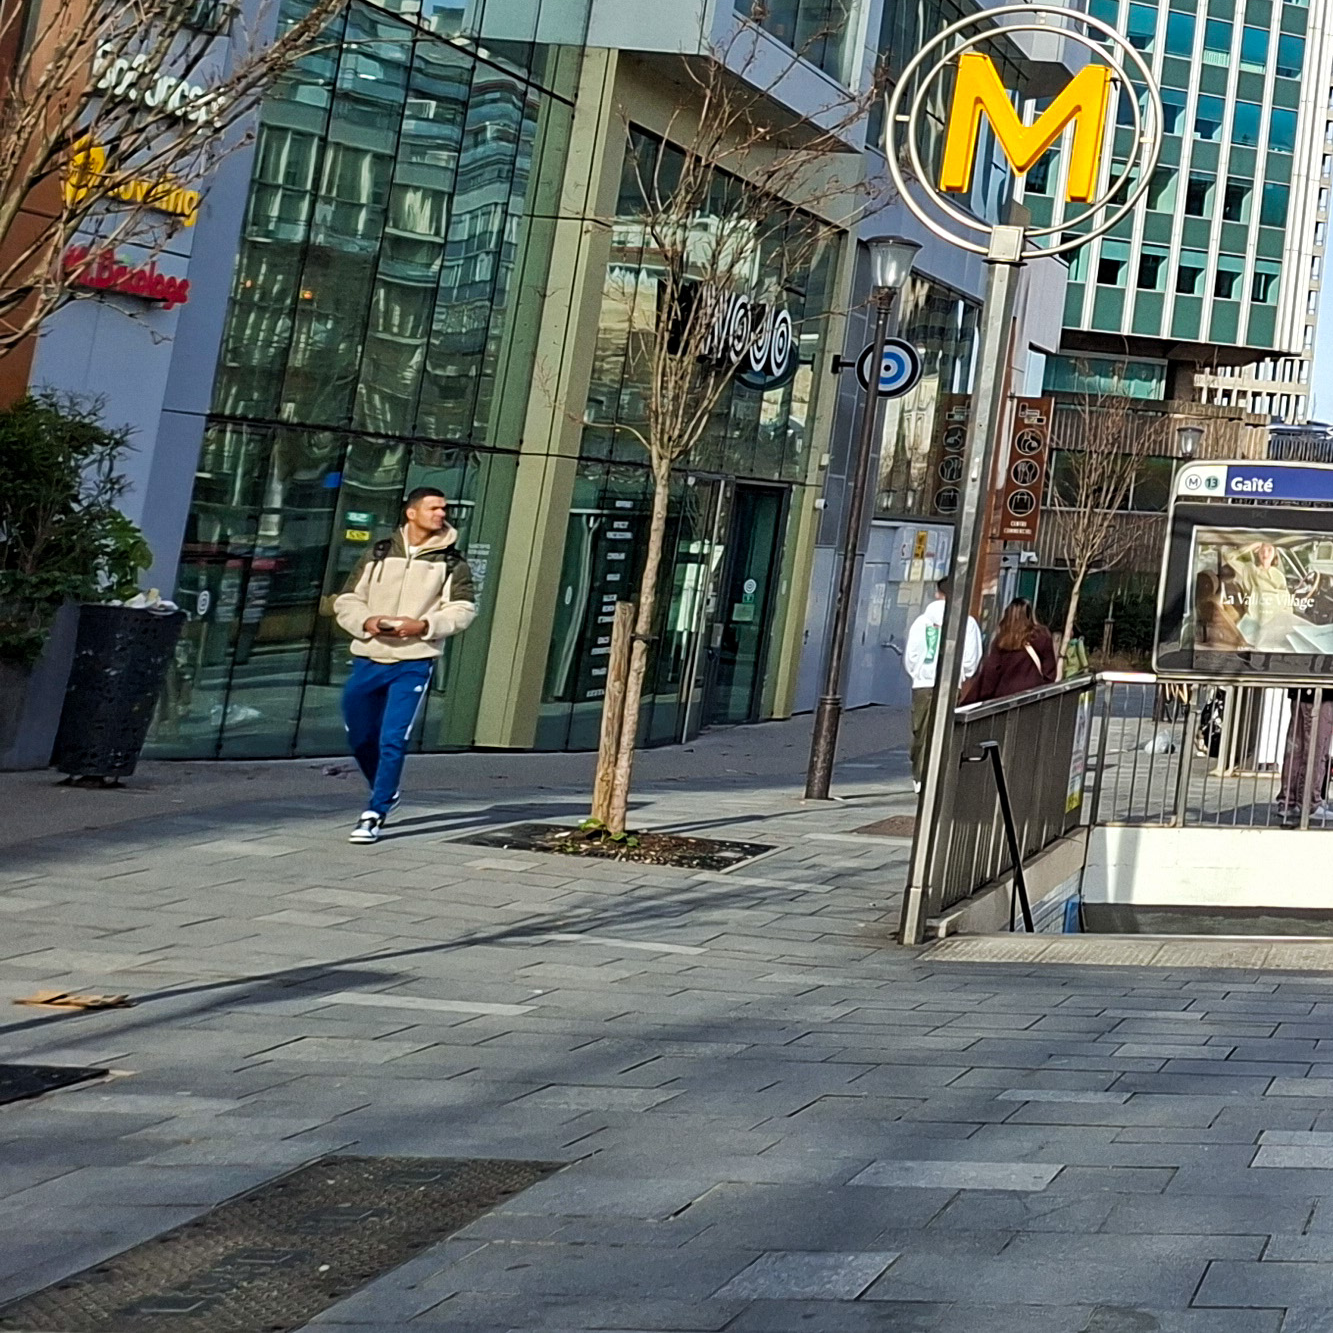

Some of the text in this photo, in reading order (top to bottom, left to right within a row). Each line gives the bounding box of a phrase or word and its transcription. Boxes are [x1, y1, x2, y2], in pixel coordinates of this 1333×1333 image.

[940, 52, 1112, 204] M
[1205, 478, 1219, 488] 13
[1231, 476, 1274, 493] Gaîté
